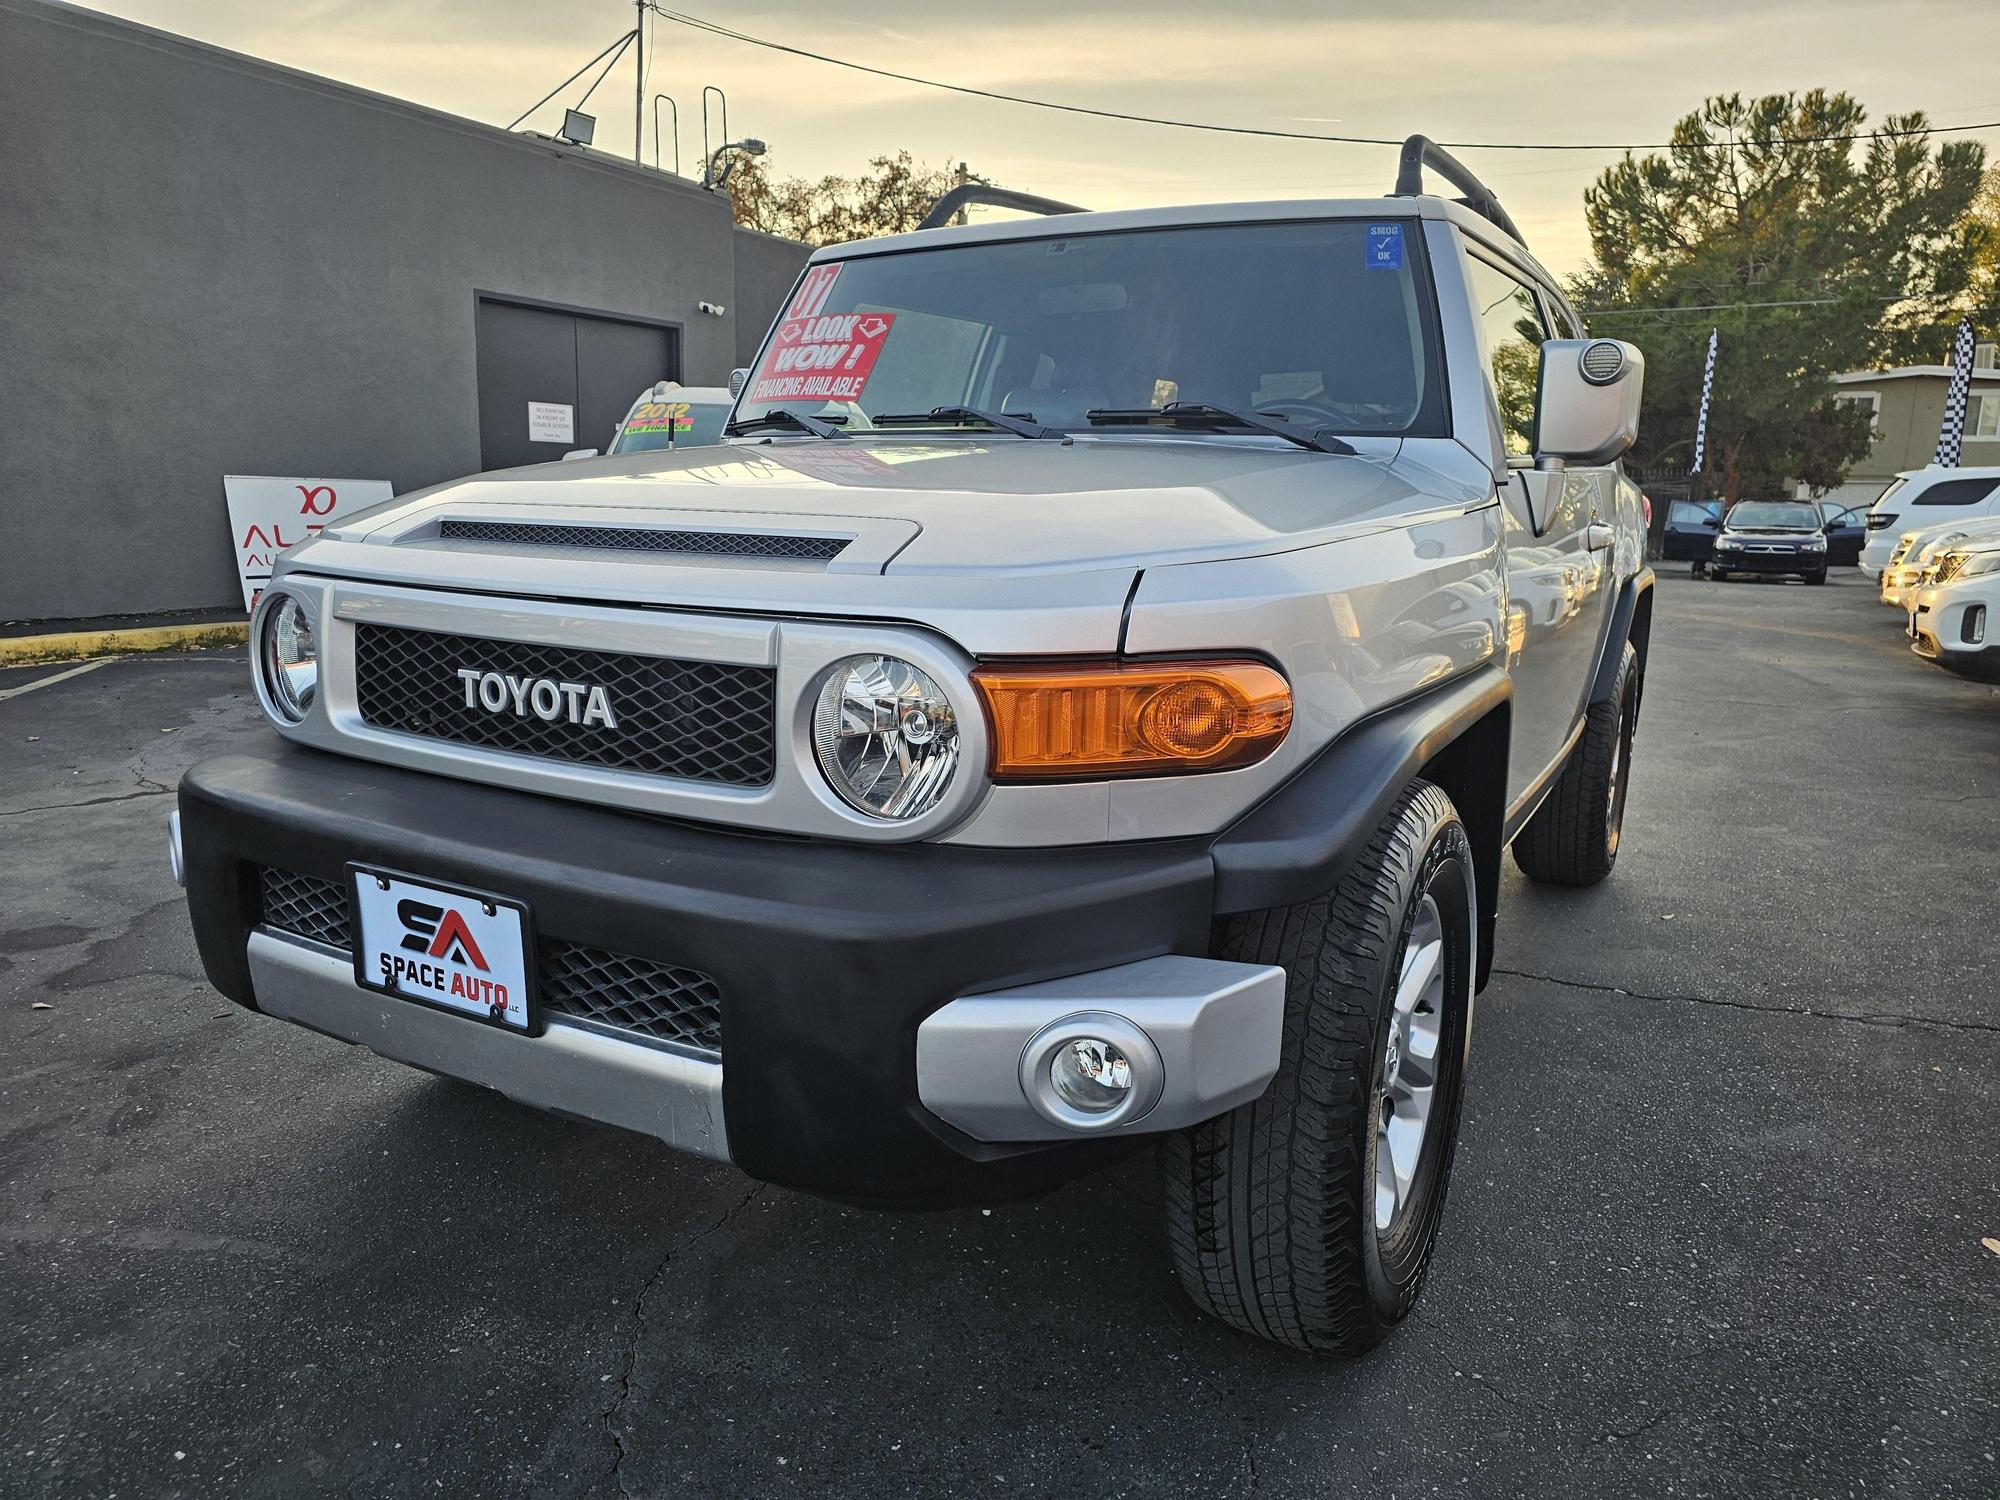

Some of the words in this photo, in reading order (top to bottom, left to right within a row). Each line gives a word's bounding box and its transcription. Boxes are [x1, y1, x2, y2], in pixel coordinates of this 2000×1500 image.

[1370, 226, 1398, 235] SMOG
[1377, 251, 1391, 260] OK
[788, 264, 841, 319] 07
[801, 314, 861, 344] LOOK
[753, 376, 804, 398] FINANCING
[802, 375, 864, 397] AVAILABLE
[545, 407, 566, 415] PARKING
[633, 402, 691, 419] 2012
[645, 424, 688, 432] FINACE
[457, 667, 619, 729] TOYOTA
[397, 898, 491, 974] SA
[380, 952, 446, 992] SPACE
[450, 972, 509, 1011] AUTO
[508, 1003, 520, 1013] LLC
